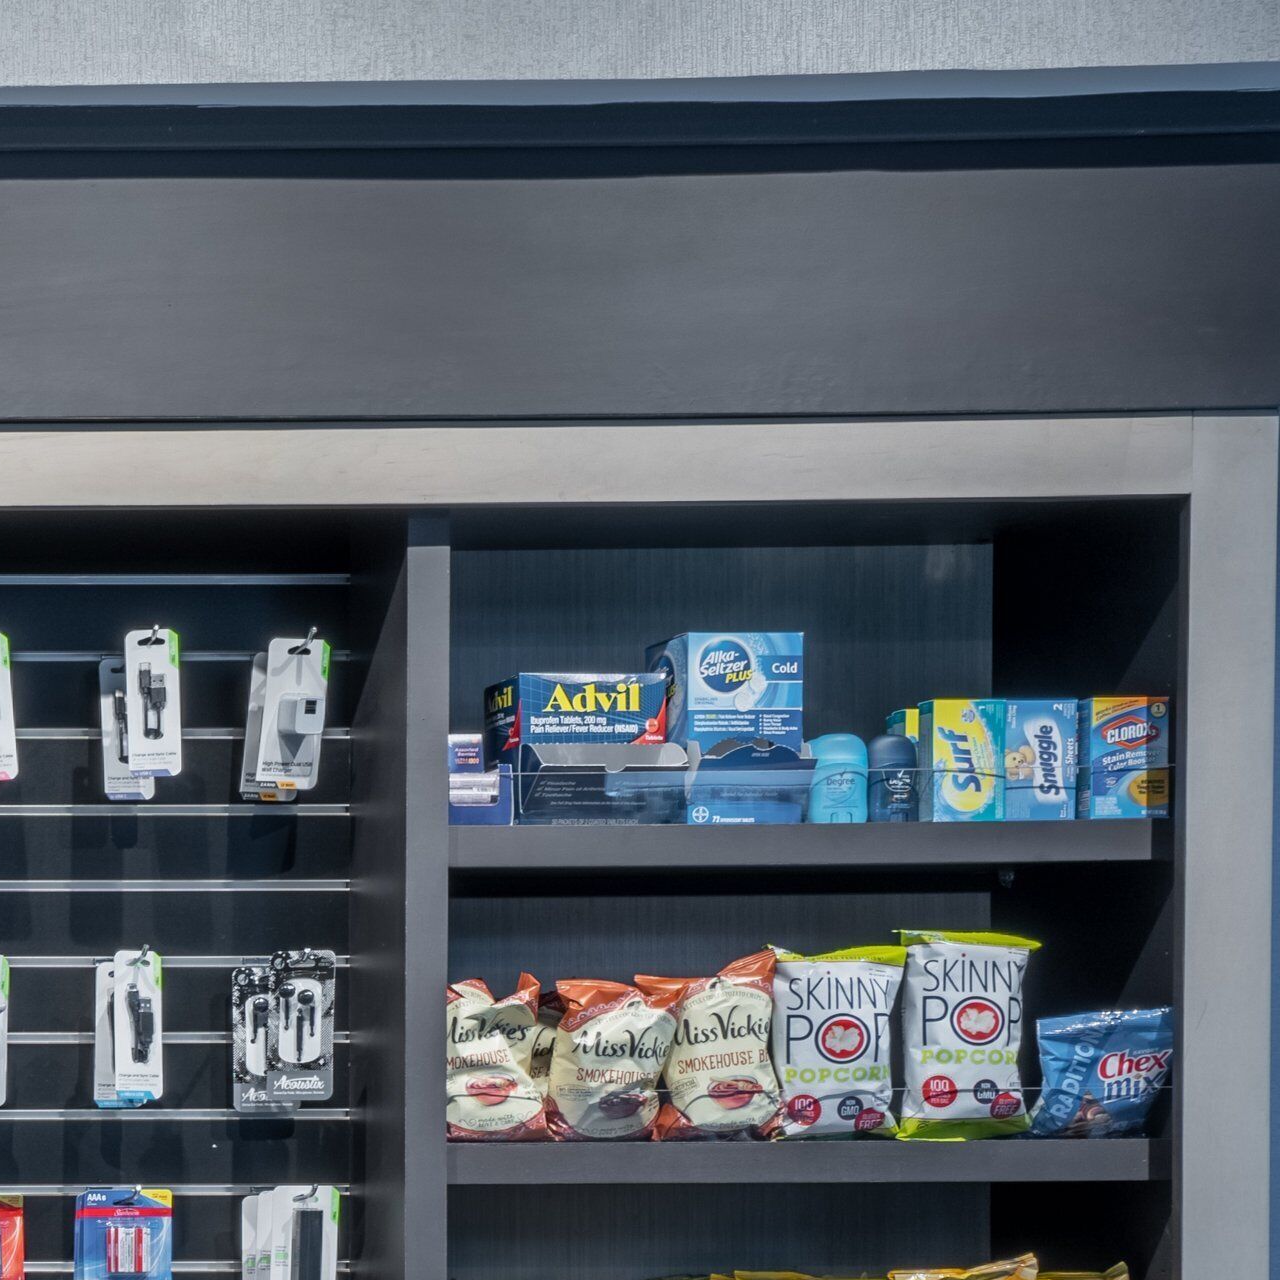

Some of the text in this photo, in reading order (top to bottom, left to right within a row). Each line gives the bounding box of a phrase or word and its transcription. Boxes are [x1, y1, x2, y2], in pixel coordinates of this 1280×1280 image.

[704, 649, 740, 666] Alka-
[700, 660, 748, 679] Seltzer
[771, 661, 798, 674] Cold
[725, 669, 754, 685] PLUS
[542, 682, 642, 712] Advil
[530, 716, 559, 725] Ibuprofen
[584, 716, 596, 724] 200
[530, 724, 638, 733] Pain Reducer (NSAID)
[937, 726, 982, 792] Surf
[1065, 738, 1074, 765] Sheets
[1102, 752, 1125, 766] Stain
[1033, 725, 1061, 796] Snuggle
[1108, 761, 1127, 771] Color
[573, 1028, 627, 1059] Miss
[446, 1049, 510, 1071] MOKEHOUSE
[676, 1053, 754, 1075] SMOKEHOUSE
[1097, 1049, 1174, 1081] Chex
[273, 1074, 325, 1090] Acoustix
[841, 1105, 860, 1116] GMO
[993, 1104, 1018, 1116] FREE
[87, 1193, 102, 1202] AAA
